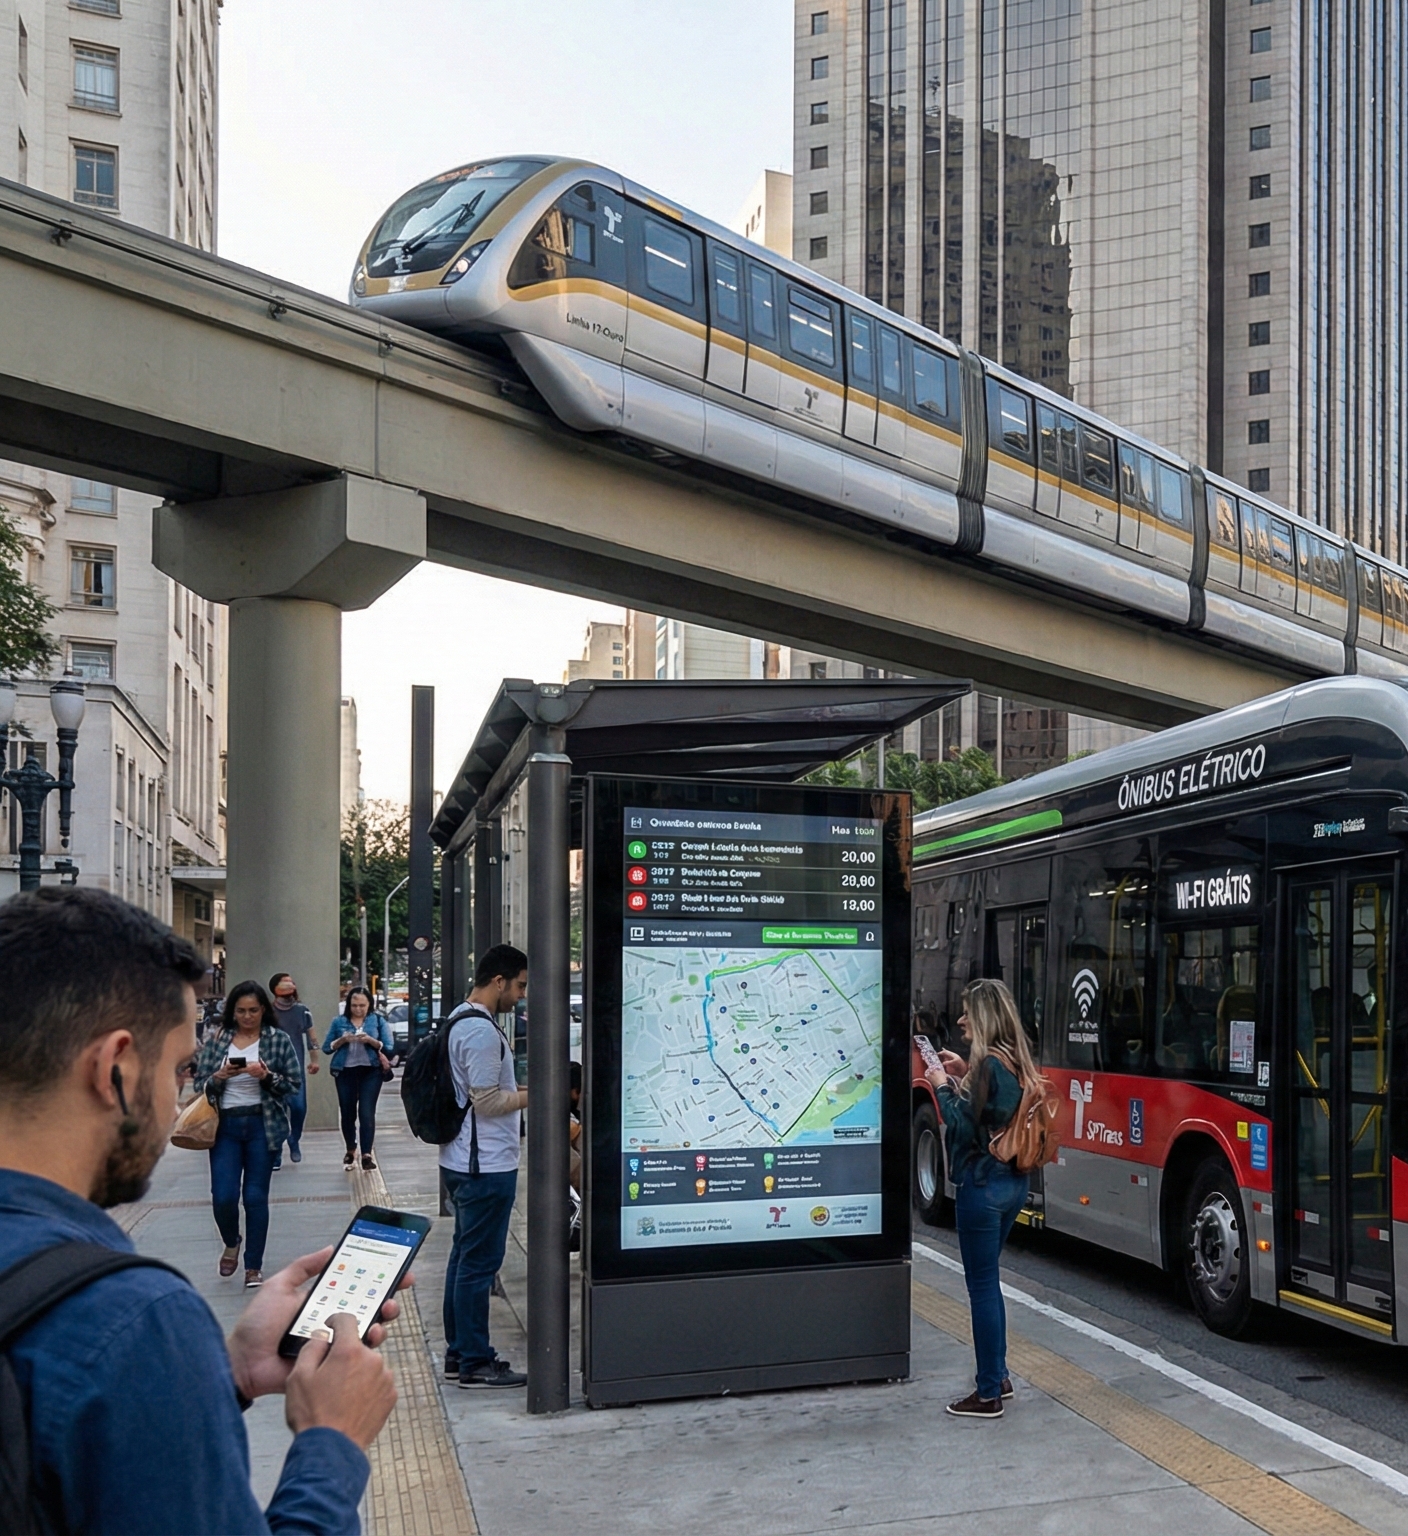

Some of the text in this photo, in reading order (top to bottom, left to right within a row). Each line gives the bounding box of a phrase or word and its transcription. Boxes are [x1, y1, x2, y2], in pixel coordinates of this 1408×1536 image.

[1178, 744, 1266, 796] ELÉTRICO
[1176, 868, 1251, 909] WI-FI GRÁTIS
